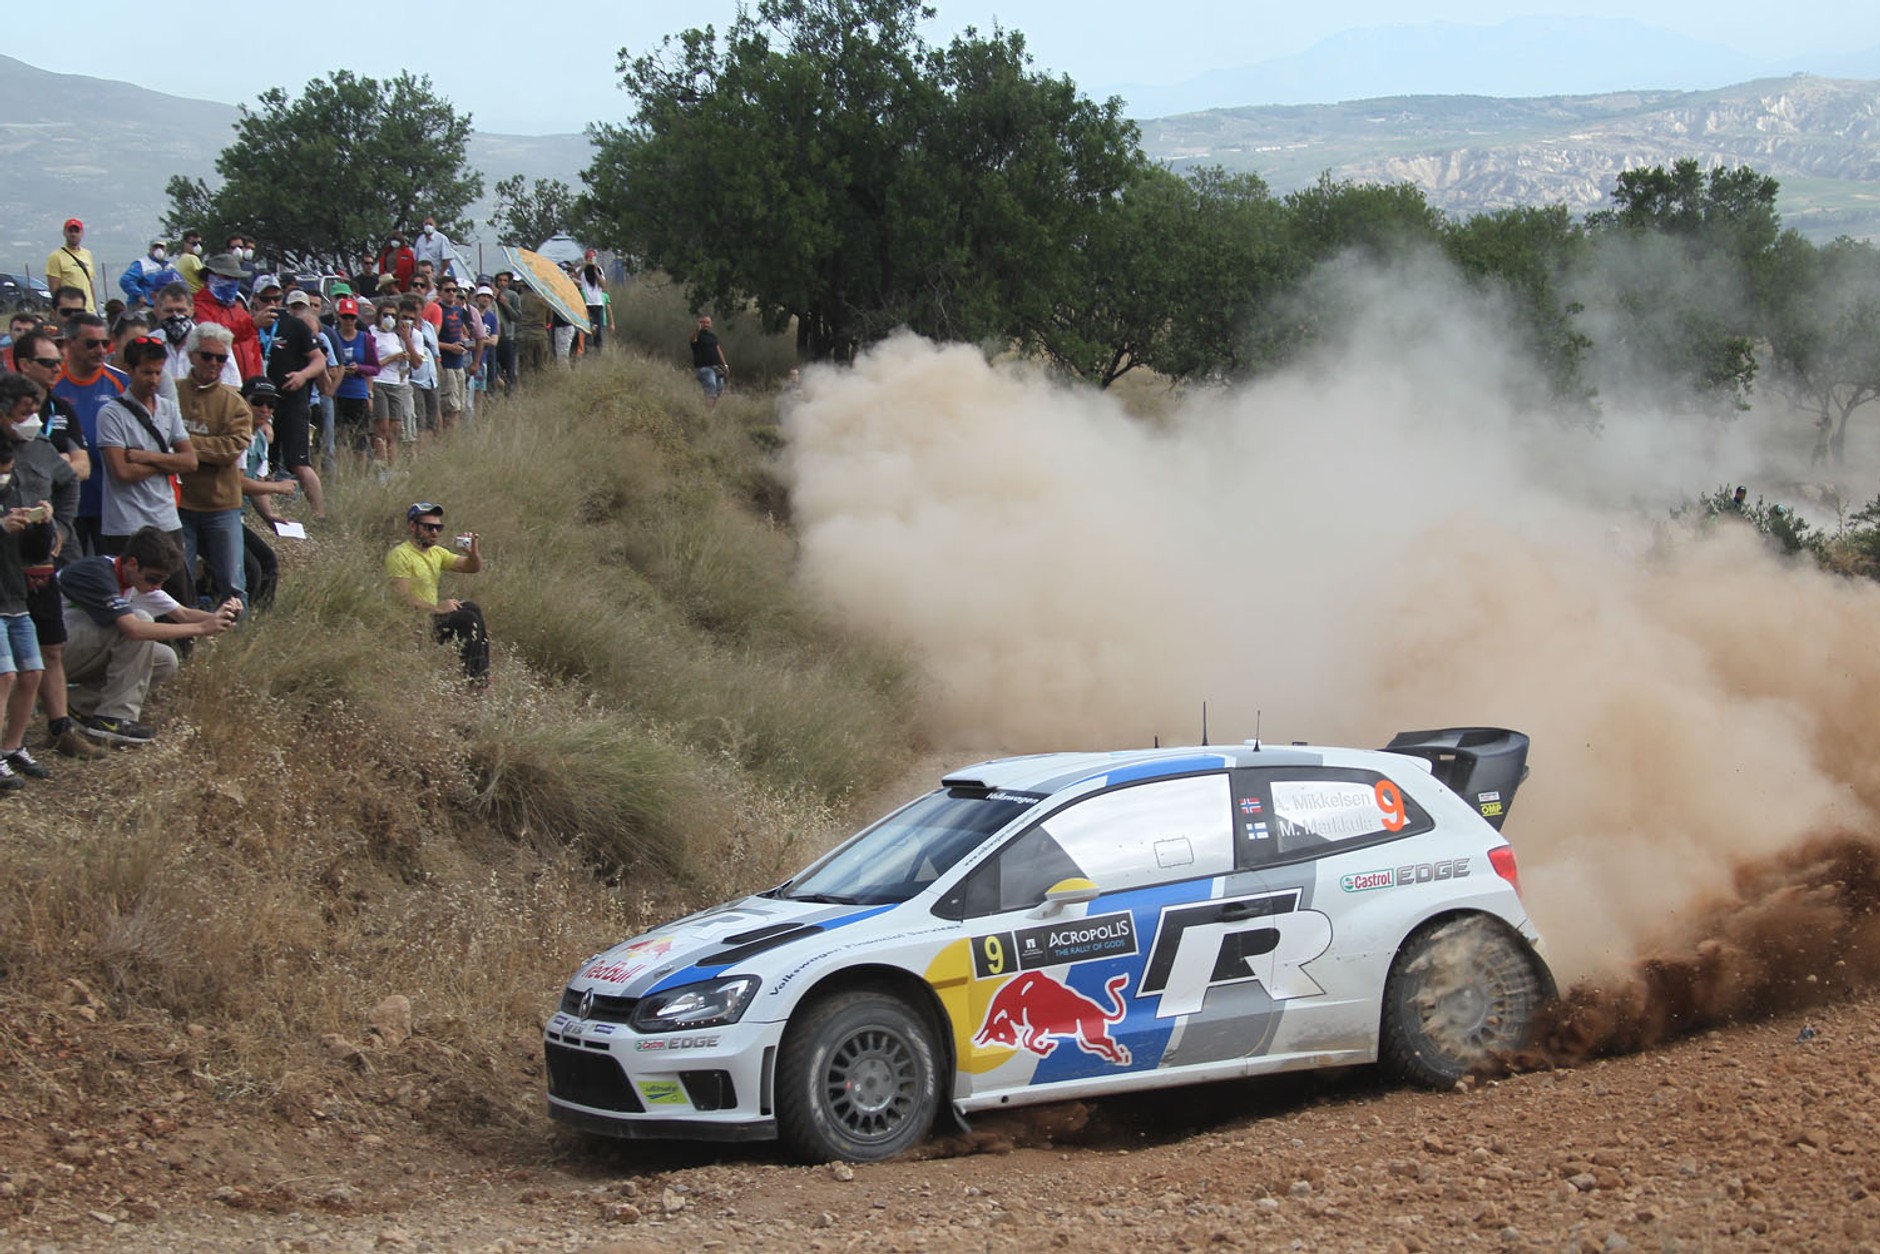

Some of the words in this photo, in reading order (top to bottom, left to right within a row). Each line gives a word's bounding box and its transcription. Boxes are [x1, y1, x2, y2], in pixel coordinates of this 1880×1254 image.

[1292, 792, 1371, 810] Mikkelsen
[1374, 779, 1405, 832] 9
[1481, 803, 1502, 816] OMP
[1279, 821, 1300, 837] M.
[1354, 871, 1391, 889] Castrol
[1396, 858, 1471, 886] EDGE
[1049, 920, 1130, 947] ACROPOLIS
[984, 935, 1004, 974] 9
[1055, 948, 1071, 957] THE
[1071, 945, 1091, 955] RALLY
[1092, 942, 1101, 951] OF
[1104, 940, 1126, 950] GODS
[1138, 888, 1333, 1019] R
[769, 947, 842, 996] Volkswagen
[668, 1035, 721, 1049] EDGE
